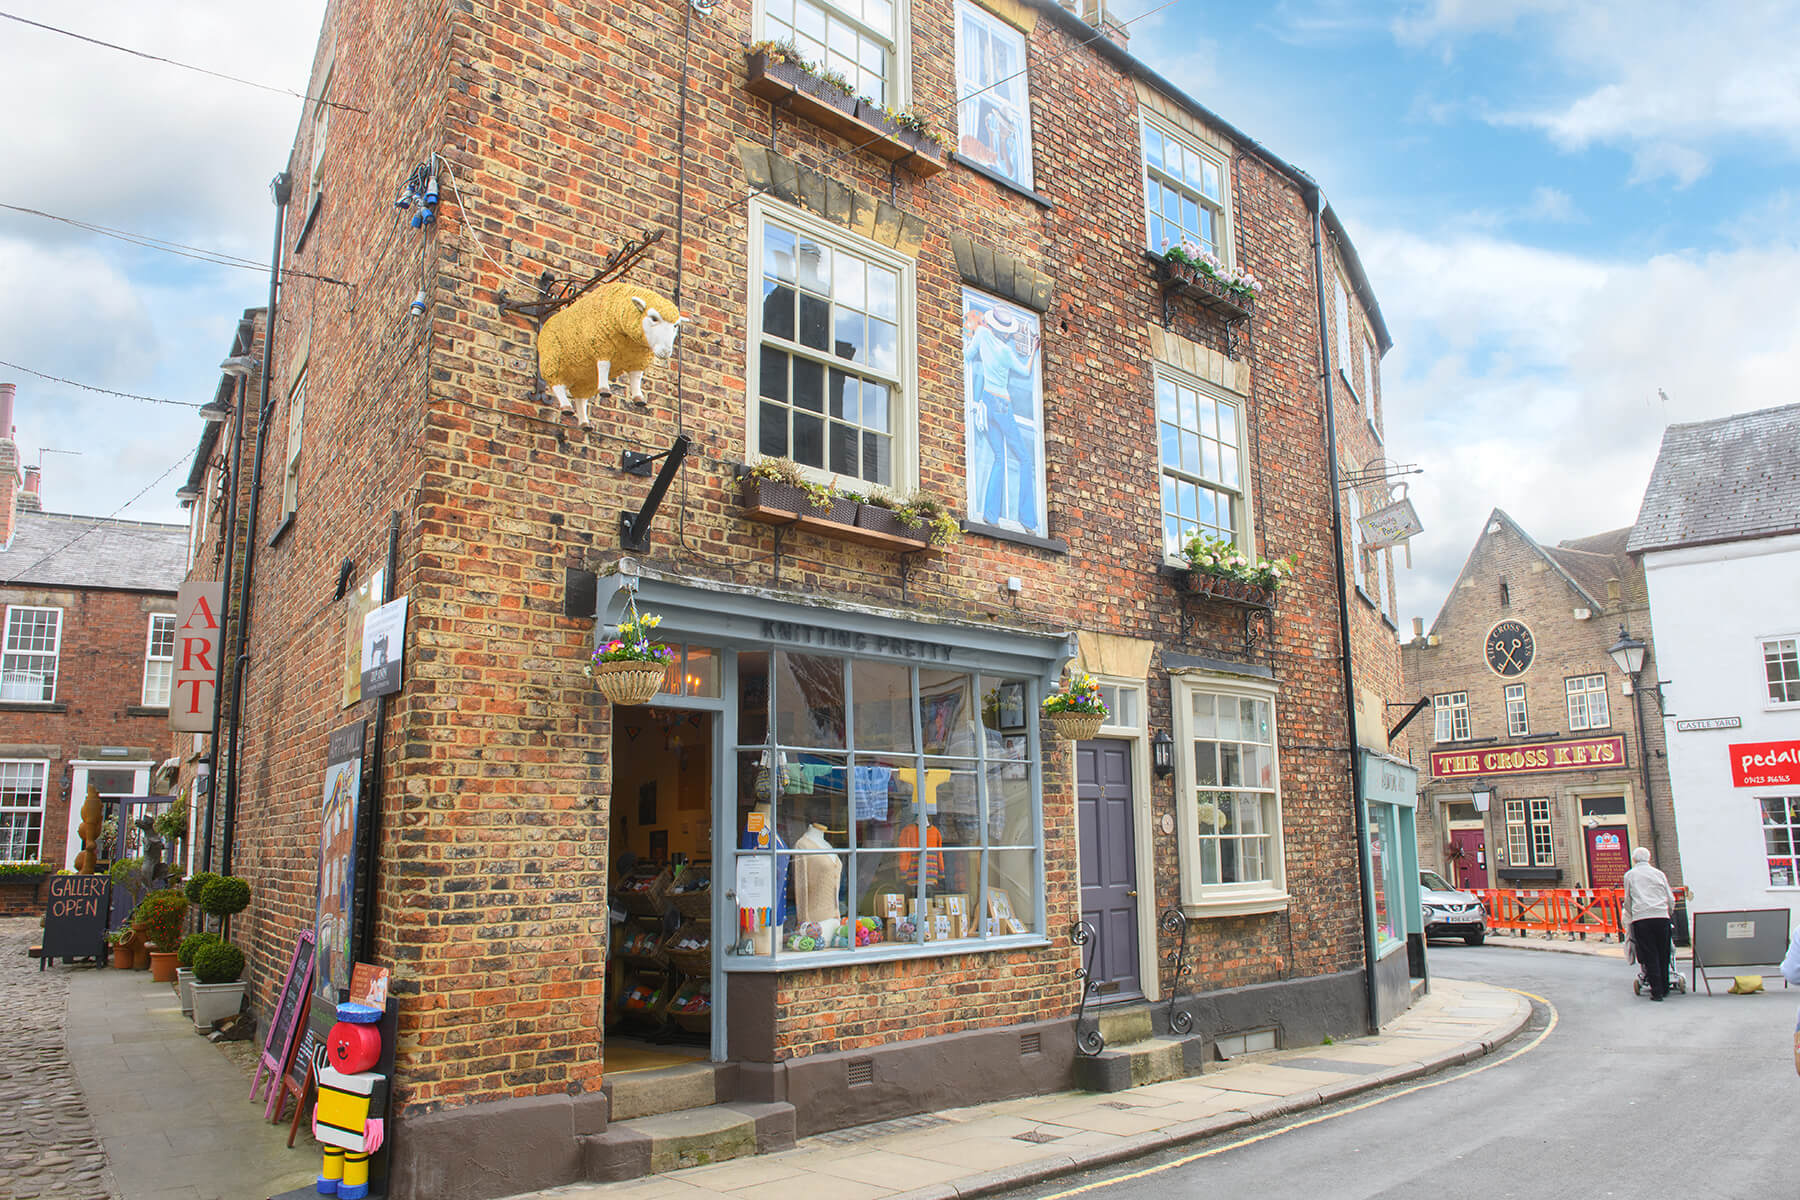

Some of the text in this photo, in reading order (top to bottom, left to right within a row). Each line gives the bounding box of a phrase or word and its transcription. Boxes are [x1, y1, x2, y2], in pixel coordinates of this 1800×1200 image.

[177, 595, 221, 714] ART
[762, 620, 953, 662] KNITTING PRETTY
[1487, 623, 1532, 660] THE CROSS KEYS
[1679, 719, 1738, 729] CASTLE YARD
[1439, 743, 1616, 774] THE CROSS KEYS
[51, 878, 109, 897] GALLERY
[52, 898, 98, 918] OPEN
